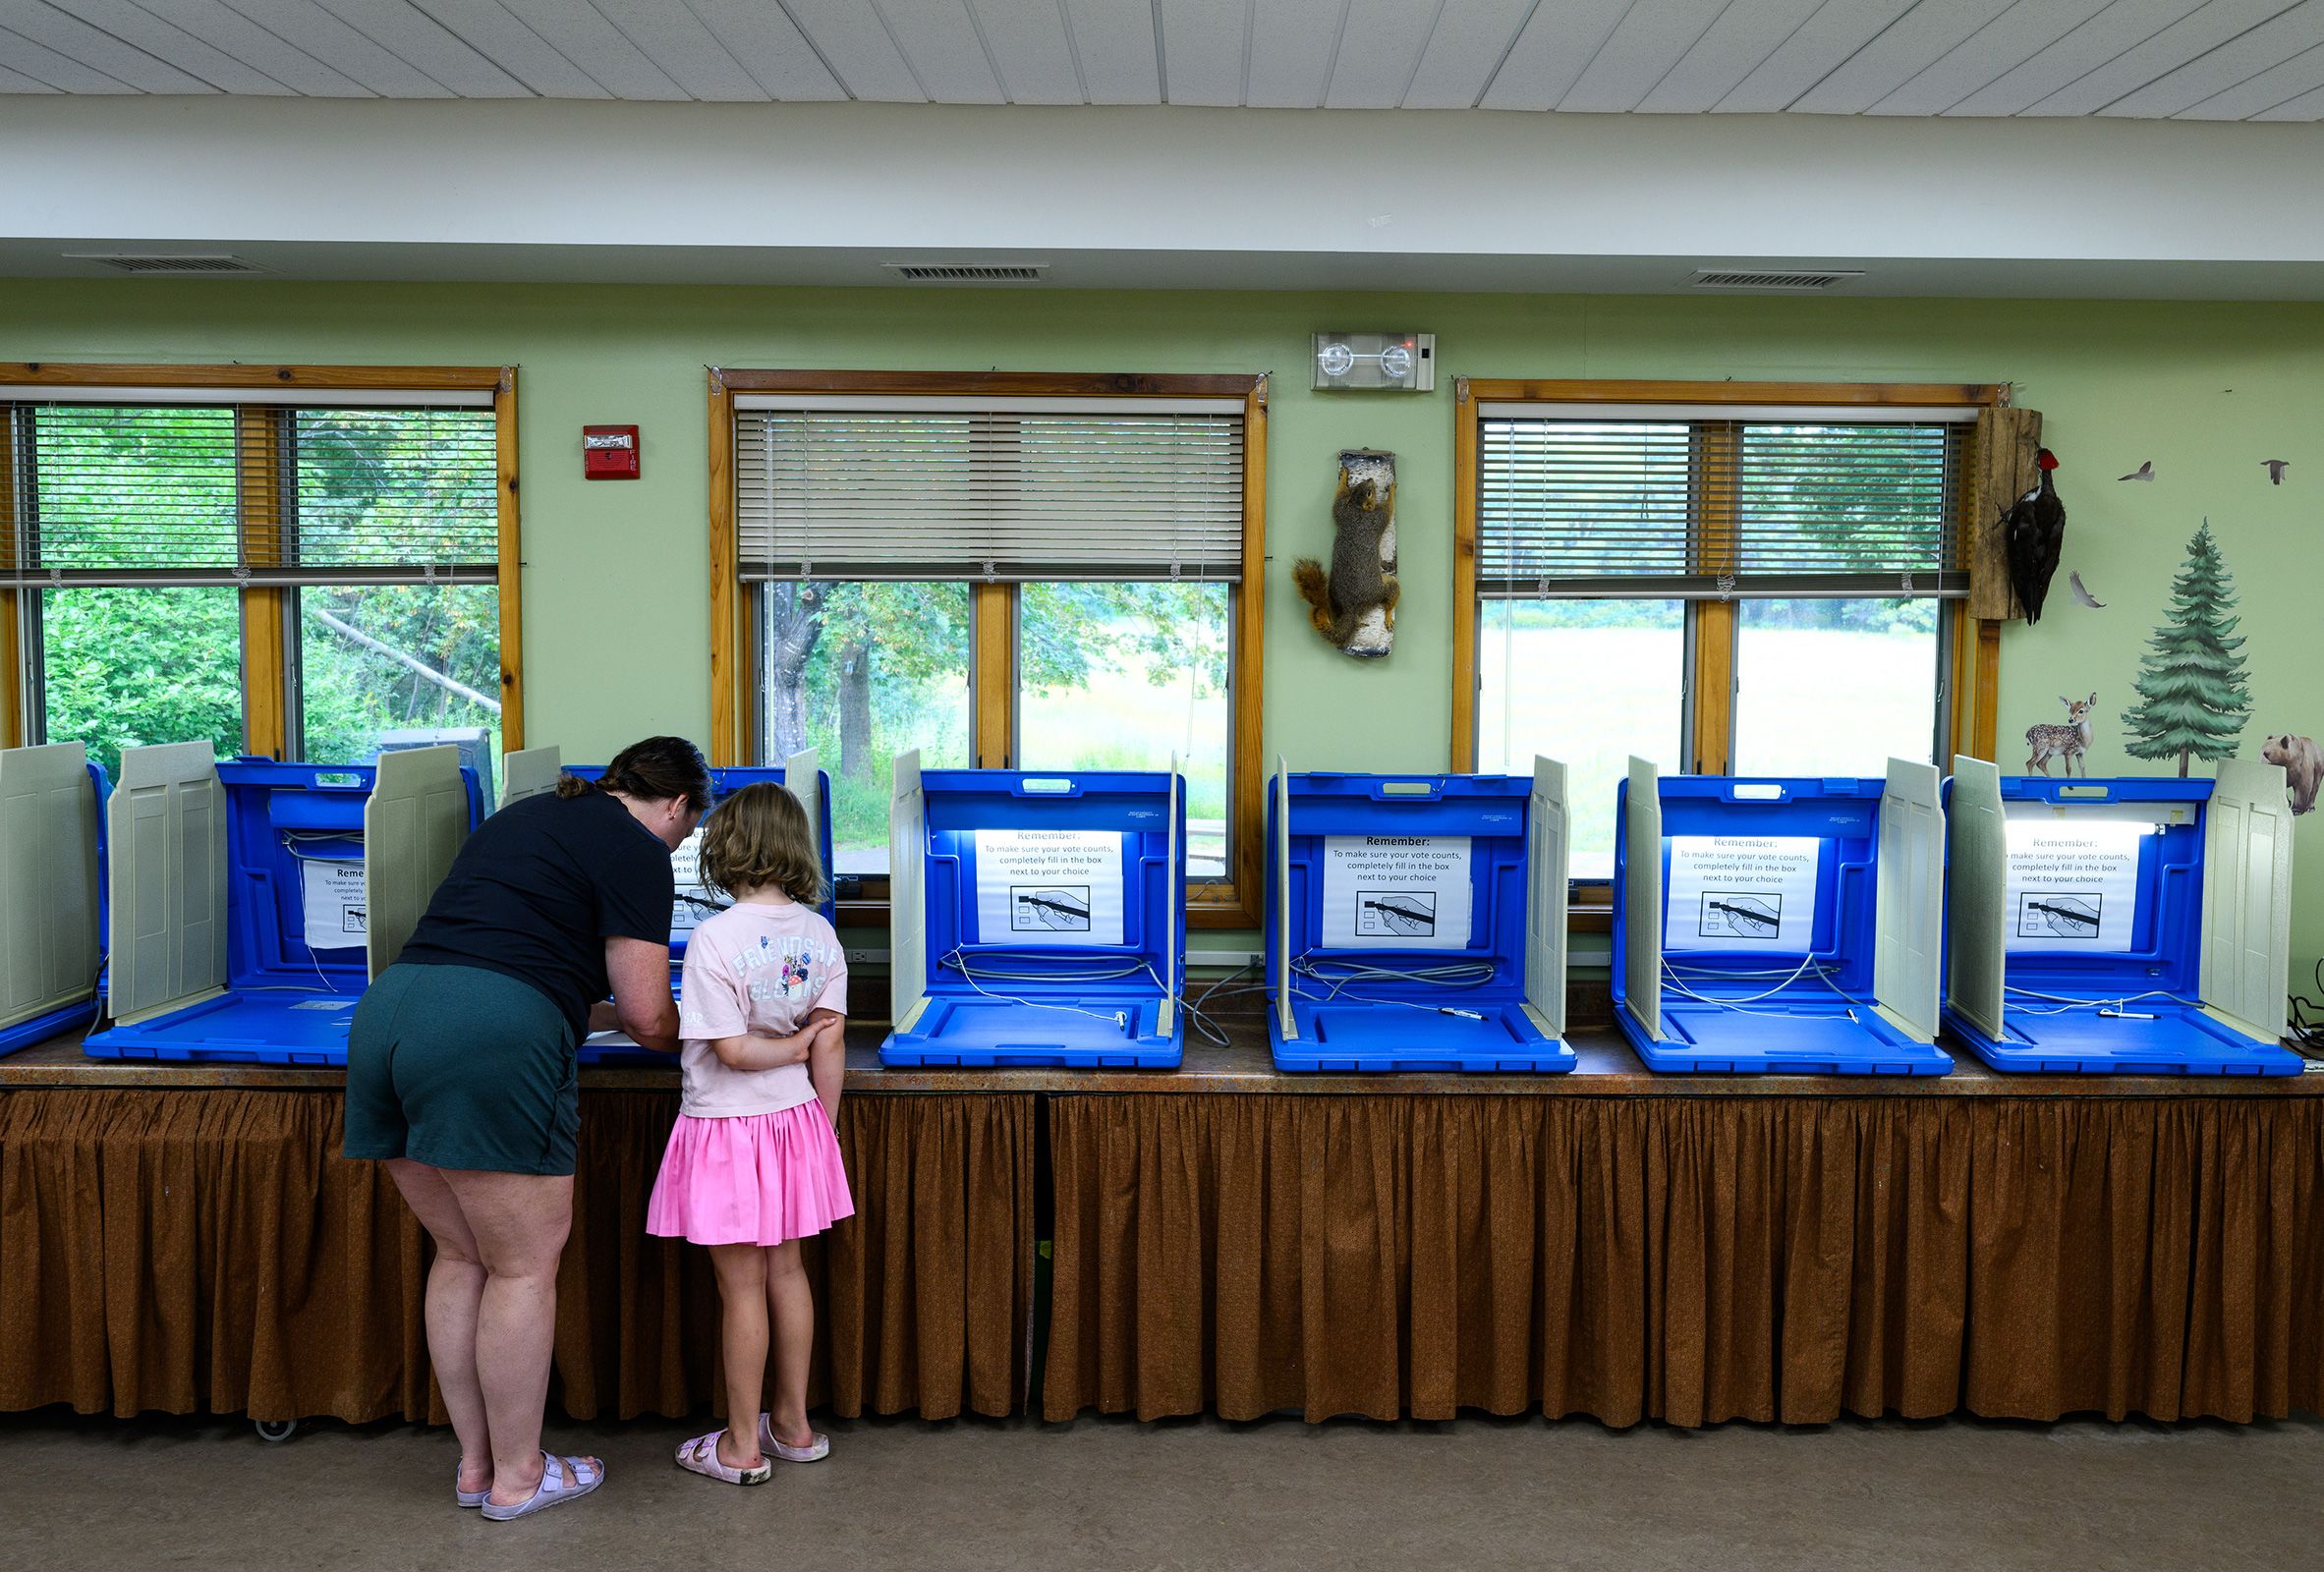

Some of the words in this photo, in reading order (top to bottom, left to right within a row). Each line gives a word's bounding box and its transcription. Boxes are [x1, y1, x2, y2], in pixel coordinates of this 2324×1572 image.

[1017, 831, 1081, 840] Remember:
[1366, 837, 1430, 846] Remember:
[1714, 838, 1777, 848] Remember:
[2033, 838, 2098, 848] Remember:
[1000, 857, 1045, 865] completely
[1347, 862, 1393, 870] completely
[1694, 863, 1740, 872] completely
[2012, 864, 2059, 872] completely
[337, 869, 364, 877] Reme
